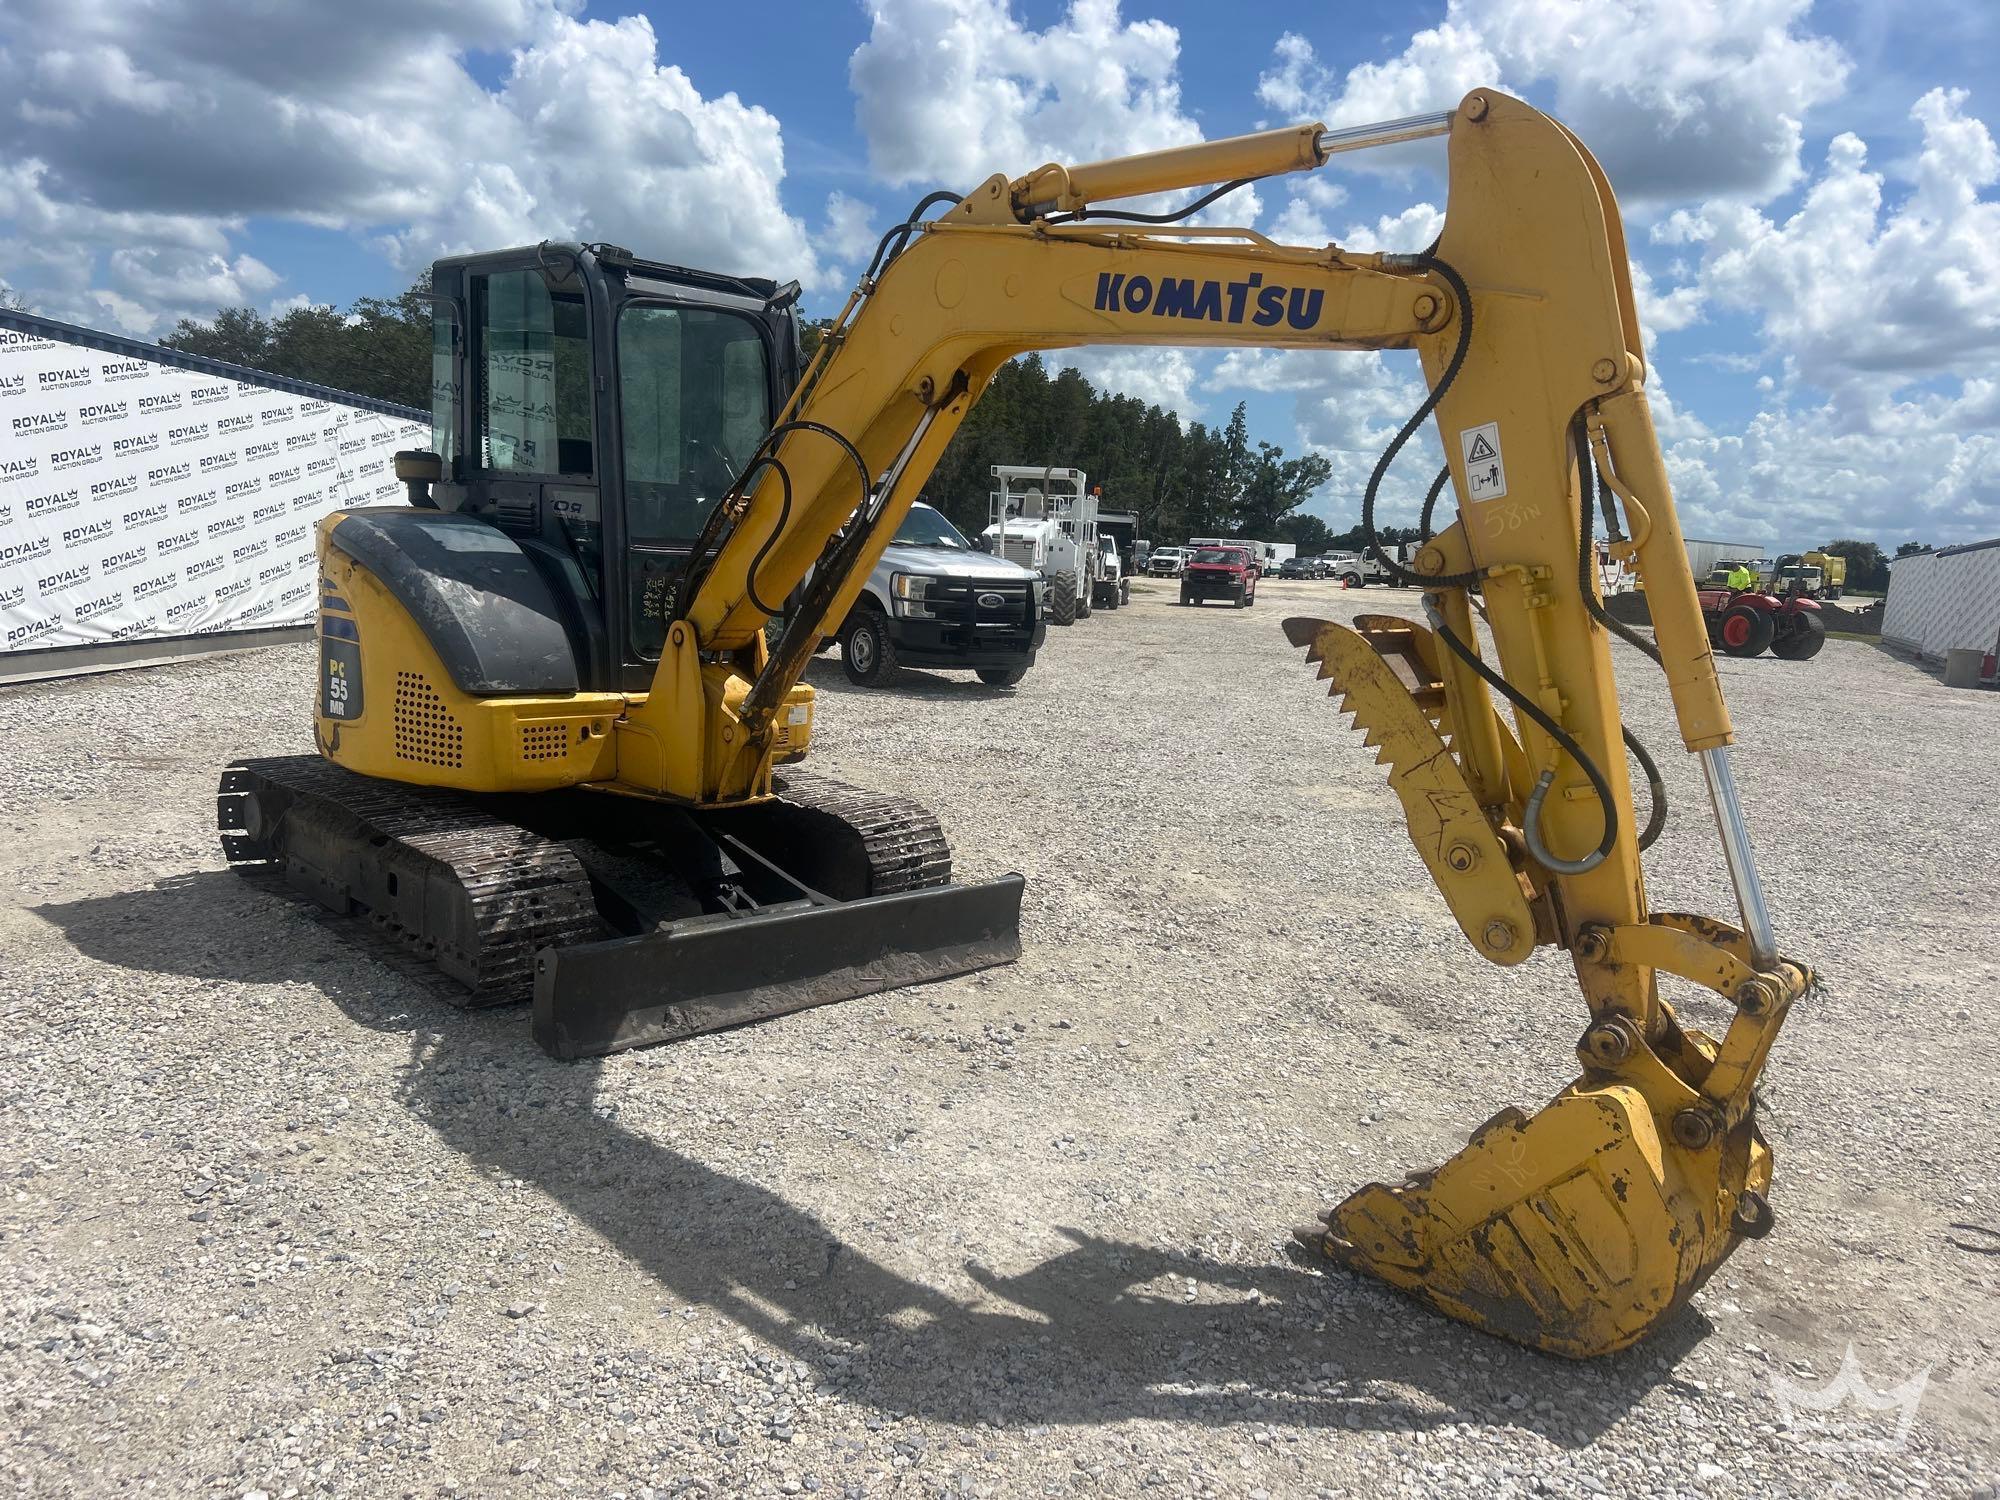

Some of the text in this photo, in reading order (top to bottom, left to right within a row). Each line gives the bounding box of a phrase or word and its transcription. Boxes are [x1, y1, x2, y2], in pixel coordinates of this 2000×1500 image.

[1095, 272, 1324, 330] KOMATSU
[2, 346, 31, 354] AUCTION
[39, 369, 79, 383] ROYAL
[102, 362, 138, 375] ROYAL
[104, 371, 149, 382] AUCTION GROUP
[2, 388, 26, 396] GROUP
[41, 379, 92, 391] AUCTION GROUP
[191, 386, 220, 399] ROYAL
[139, 394, 172, 408] ROYAL
[140, 403, 182, 415] AUCTION GROUP
[192, 397, 213, 405] AUCTION
[301, 401, 324, 411] ROYAL
[80, 403, 117, 418] ROYAL
[82, 412, 129, 425] AUCTION GROUP
[261, 407, 286, 420] ROYAL
[13, 413, 55, 429] ROYAL
[218, 416, 245, 429] ROYAL
[15, 423, 68, 437] AUCTION GROUP
[169, 425, 200, 439] ROYAL
[371, 431, 390, 442] ROYAL
[114, 435, 148, 450] ROYAL
[170, 433, 209, 446] AUCTION GROUP
[286, 433, 310, 445] ROYAL
[340, 439, 360, 450] ROYAL
[51, 447, 91, 463] ROYAL
[115, 444, 159, 458] AUCTION GROUP
[246, 442, 271, 456] ROYAL
[0, 460, 26, 474] YAL
[53, 456, 103, 471] AUCTION GROUP
[200, 453, 229, 467] ROYAL
[307, 458, 329, 471] ROYAL
[359, 461, 378, 473] ROYAL
[16, 470, 39, 480] GROUP
[149, 464, 181, 480] ROYAL
[150, 472, 191, 487] AUCTION GROUP
[269, 468, 293, 482] ROYAL
[91, 477, 127, 494] ROYAL
[92, 485, 138, 502] AUCTION GROUP
[226, 480, 253, 494] ROYAL
[26, 492, 67, 511] ROYAL
[178, 492, 208, 508] ROYAL
[293, 492, 316, 505] ROYAL
[28, 501, 80, 519] AUCTION GROUP
[179, 499, 217, 515] AUCTION GROUP
[253, 504, 278, 519] ROYAL
[0, 518, 13, 526] OUP
[123, 507, 157, 524] ROYAL
[125, 514, 168, 531] AUCTION GROUP
[64, 523, 102, 542] ROYAL
[208, 517, 236, 533] ROYAL
[66, 530, 114, 549] AUCTION GROUP
[158, 532, 189, 550] ROYAL
[275, 528, 299, 543] ROYAL
[28, 549, 51, 560] GROUP
[159, 539, 199, 557] AUCTION GROUP
[234, 542, 260, 558] ROYAL
[102, 549, 137, 569] ROYAL
[103, 556, 148, 576] AUCTION GROUP
[186, 558, 216, 576] ROYAL
[38, 569, 79, 590] ROYAL
[188, 564, 225, 582] AUCTION GROUP
[259, 564, 284, 580] ROYAL
[40, 576, 91, 597] AUCTION GROUP
[133, 576, 166, 595] ROYAL
[135, 582, 176, 602] AUCTION GROUP
[216, 580, 243, 598] ROYAL
[281, 585, 305, 602] ROYAL
[2, 598, 26, 610] GROUP
[75, 596, 112, 617] ROYAL
[167, 599, 197, 618] ROYAL
[241, 602, 266, 620] ROYAL
[77, 602, 124, 624] AUCTION GROUP
[168, 604, 207, 624] AUCTION GROUP
[7, 618, 50, 642] ROYAL
[10, 624, 63, 649] AUCTION GROUP
[112, 620, 148, 640] ROYAL
[330, 659, 345, 677] PC
[330, 677, 348, 700] 55
[330, 700, 345, 716] MR
